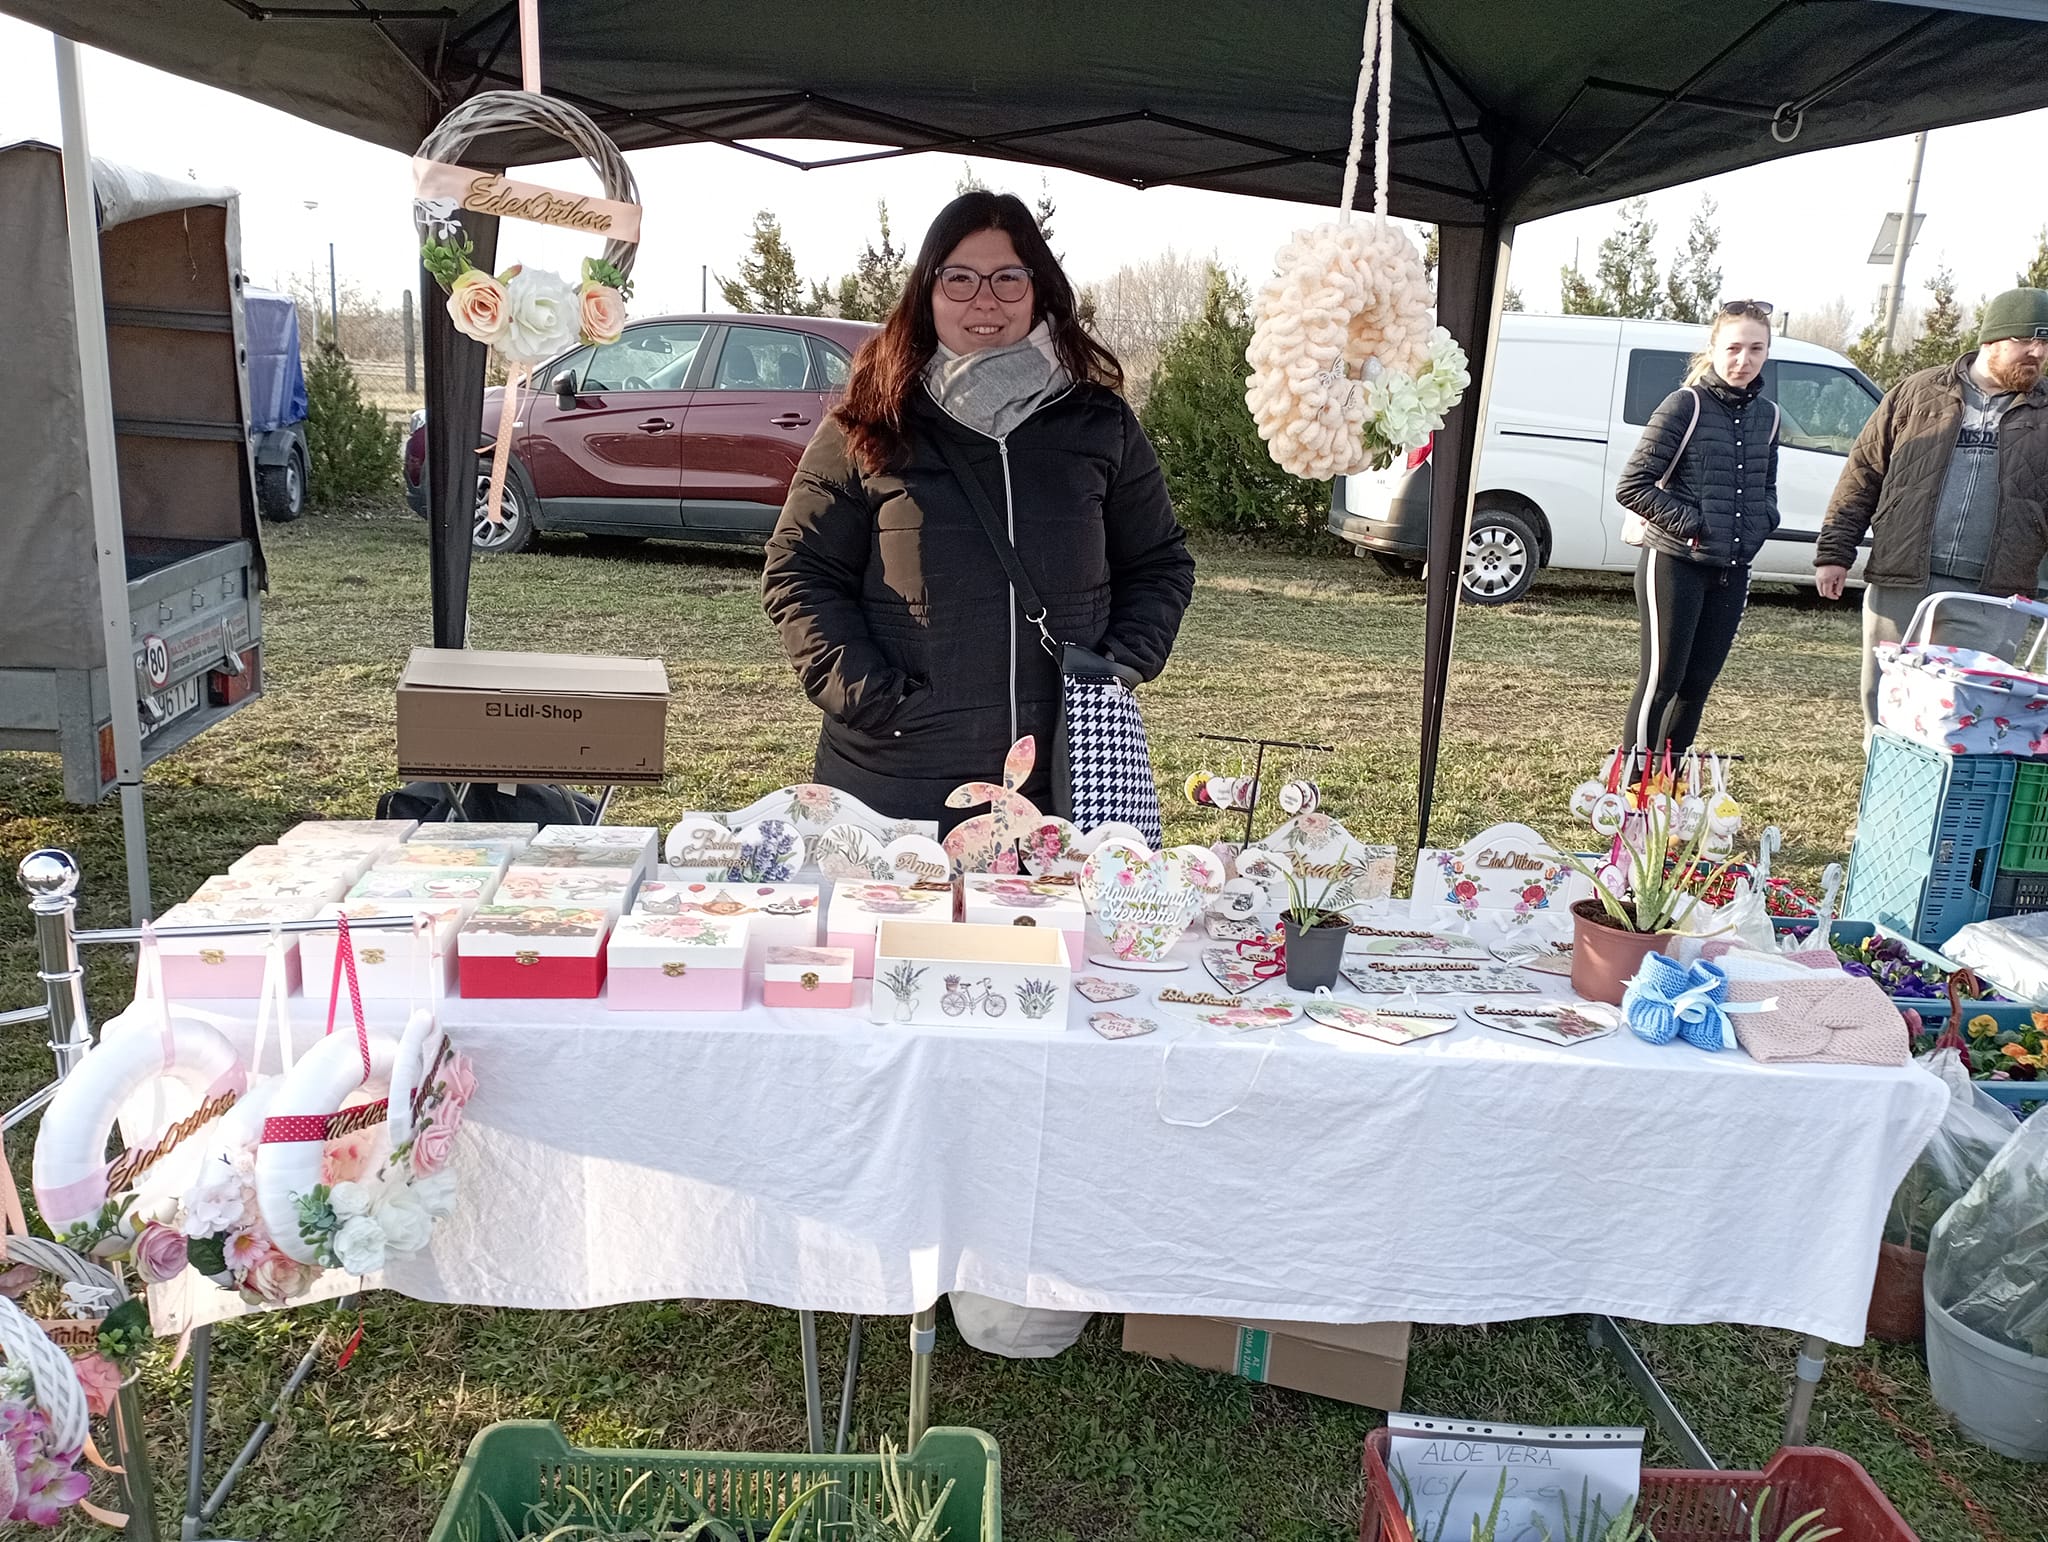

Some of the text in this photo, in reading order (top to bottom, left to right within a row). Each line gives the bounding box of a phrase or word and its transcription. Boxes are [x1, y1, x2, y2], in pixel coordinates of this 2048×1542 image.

[150, 646, 165, 676] 80
[504, 703, 583, 723] Lidl-Shop
[896, 851, 946, 882] Anya
[1421, 1441, 1554, 1466] ALOE VERA
